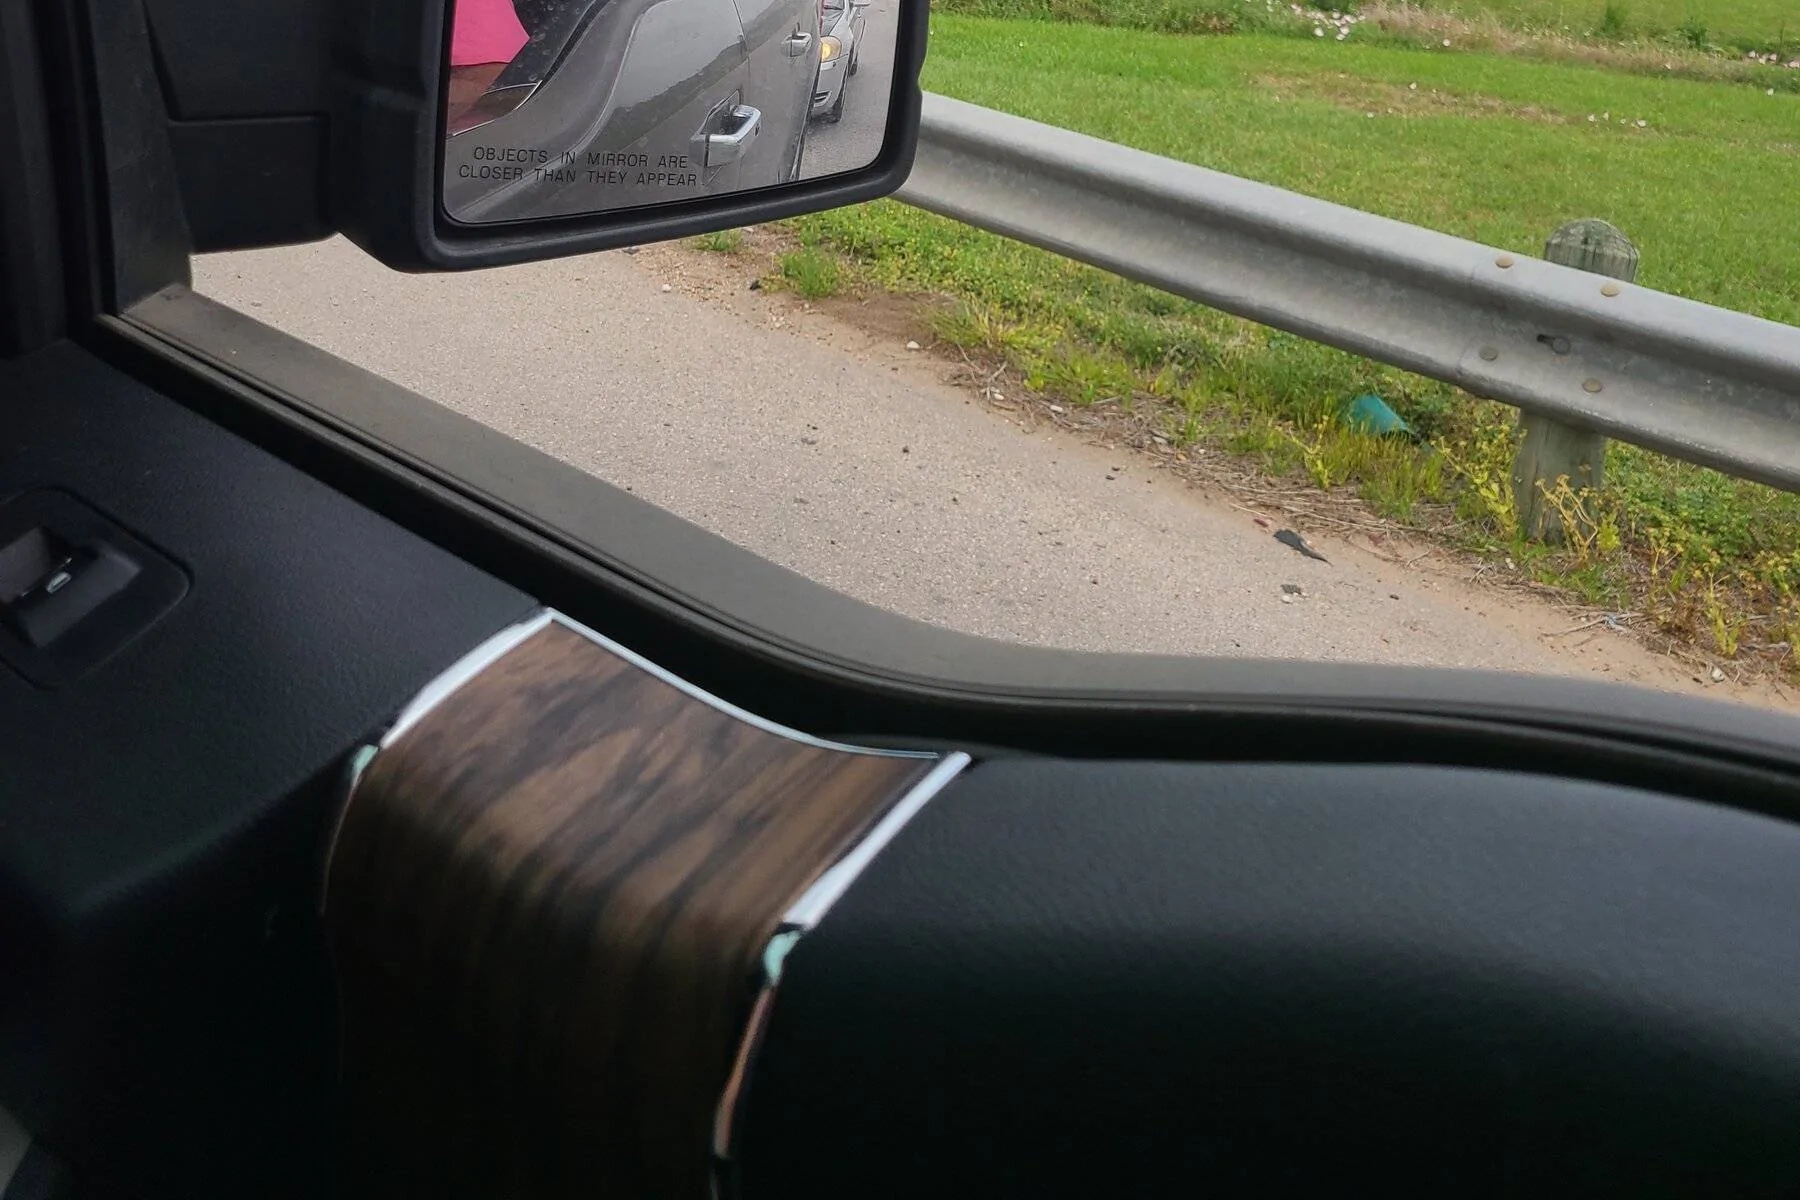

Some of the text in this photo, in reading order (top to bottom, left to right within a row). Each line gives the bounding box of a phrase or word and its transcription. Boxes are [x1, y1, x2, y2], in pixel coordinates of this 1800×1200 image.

[473, 146, 689, 169] OBJECTS IN MIRROR ARE
[458, 164, 698, 187] CLOSER THAN THEY APPEAR
